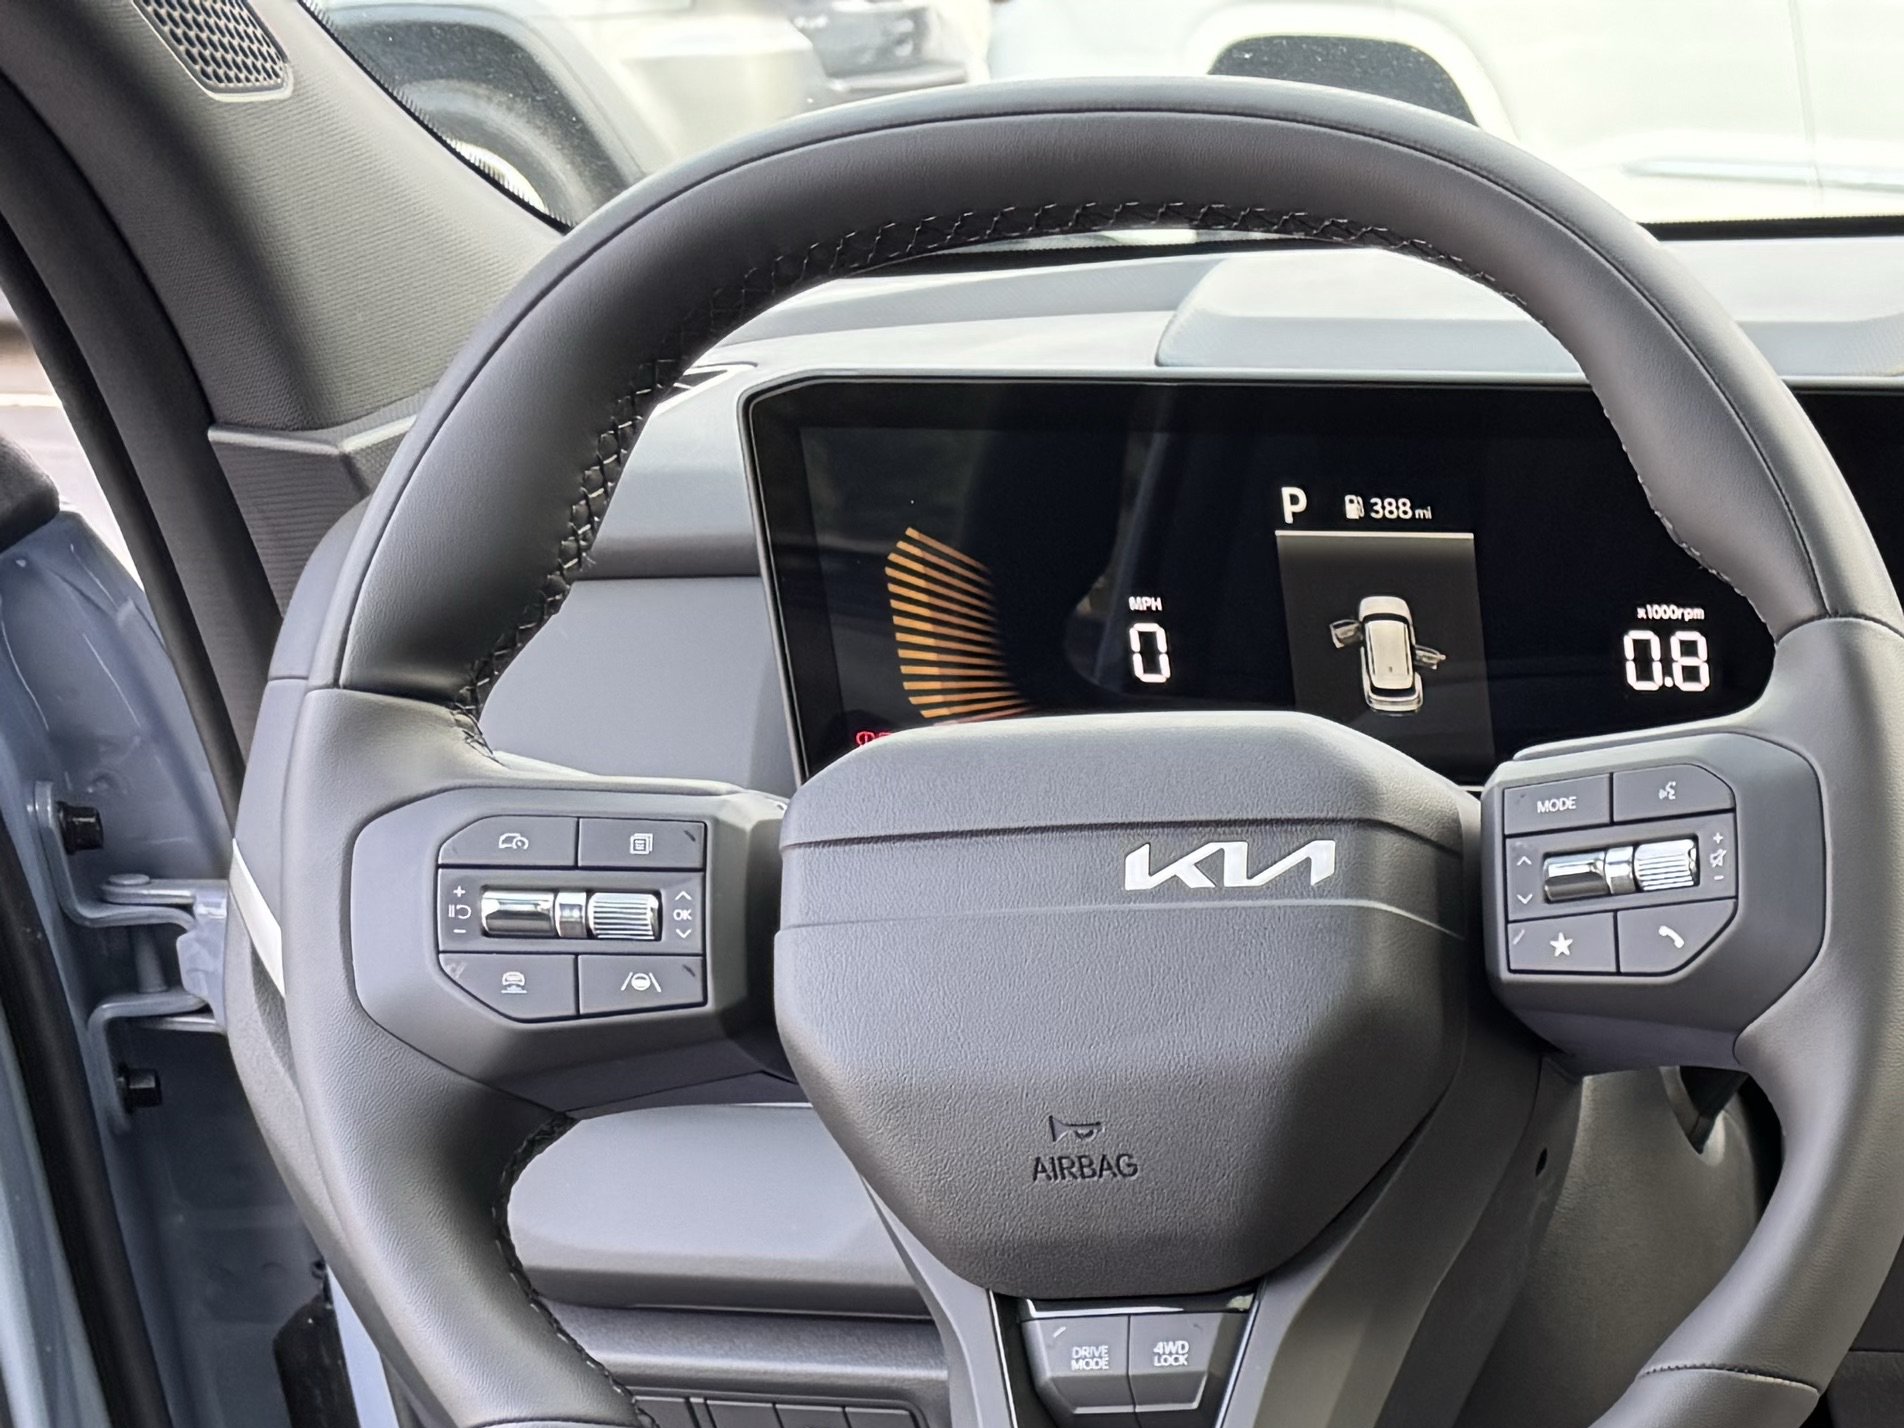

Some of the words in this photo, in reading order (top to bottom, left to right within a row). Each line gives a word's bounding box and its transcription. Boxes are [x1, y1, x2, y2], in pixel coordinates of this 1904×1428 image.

[1281, 486, 1307, 524] P
[1369, 497, 1412, 520] 388
[1128, 597, 1163, 612] MPH
[1637, 604, 1705, 621] x1000rpm
[1129, 622, 1171, 684] 0
[1623, 630, 1710, 692] 0.8
[1537, 796, 1577, 813] MODE
[1125, 840, 1336, 890] KIA
[673, 908, 693, 921] OK
[1032, 1153, 1139, 1182] AIRBAG
[1071, 1345, 1109, 1359] DRIVE
[1153, 1340, 1190, 1355] 4WD
[1071, 1357, 1110, 1371] MODE
[1153, 1354, 1189, 1367] LOCK
